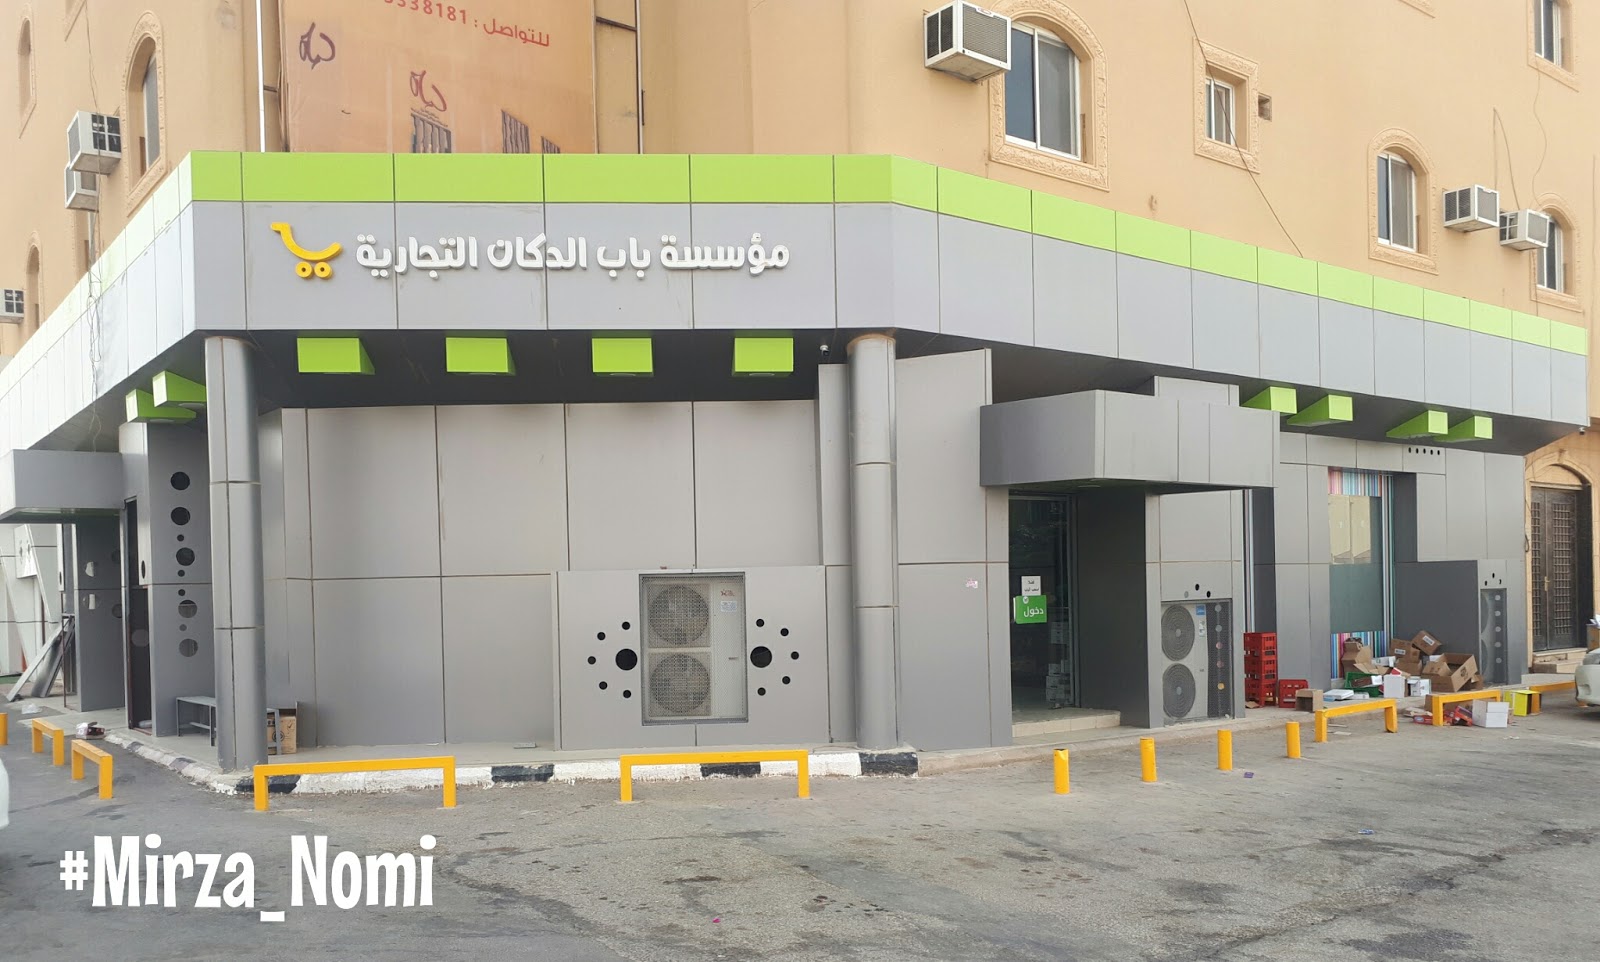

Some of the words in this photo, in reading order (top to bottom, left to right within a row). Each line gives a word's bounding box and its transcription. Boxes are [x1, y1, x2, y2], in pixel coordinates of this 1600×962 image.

[483, 18, 550, 47] للتواصل
[356, 233, 480, 280] التجارية
[486, 232, 587, 270] الدكان
[596, 236, 651, 278] باب
[659, 232, 790, 277] مؤسسة
[1023, 606, 1044, 617] دخول
